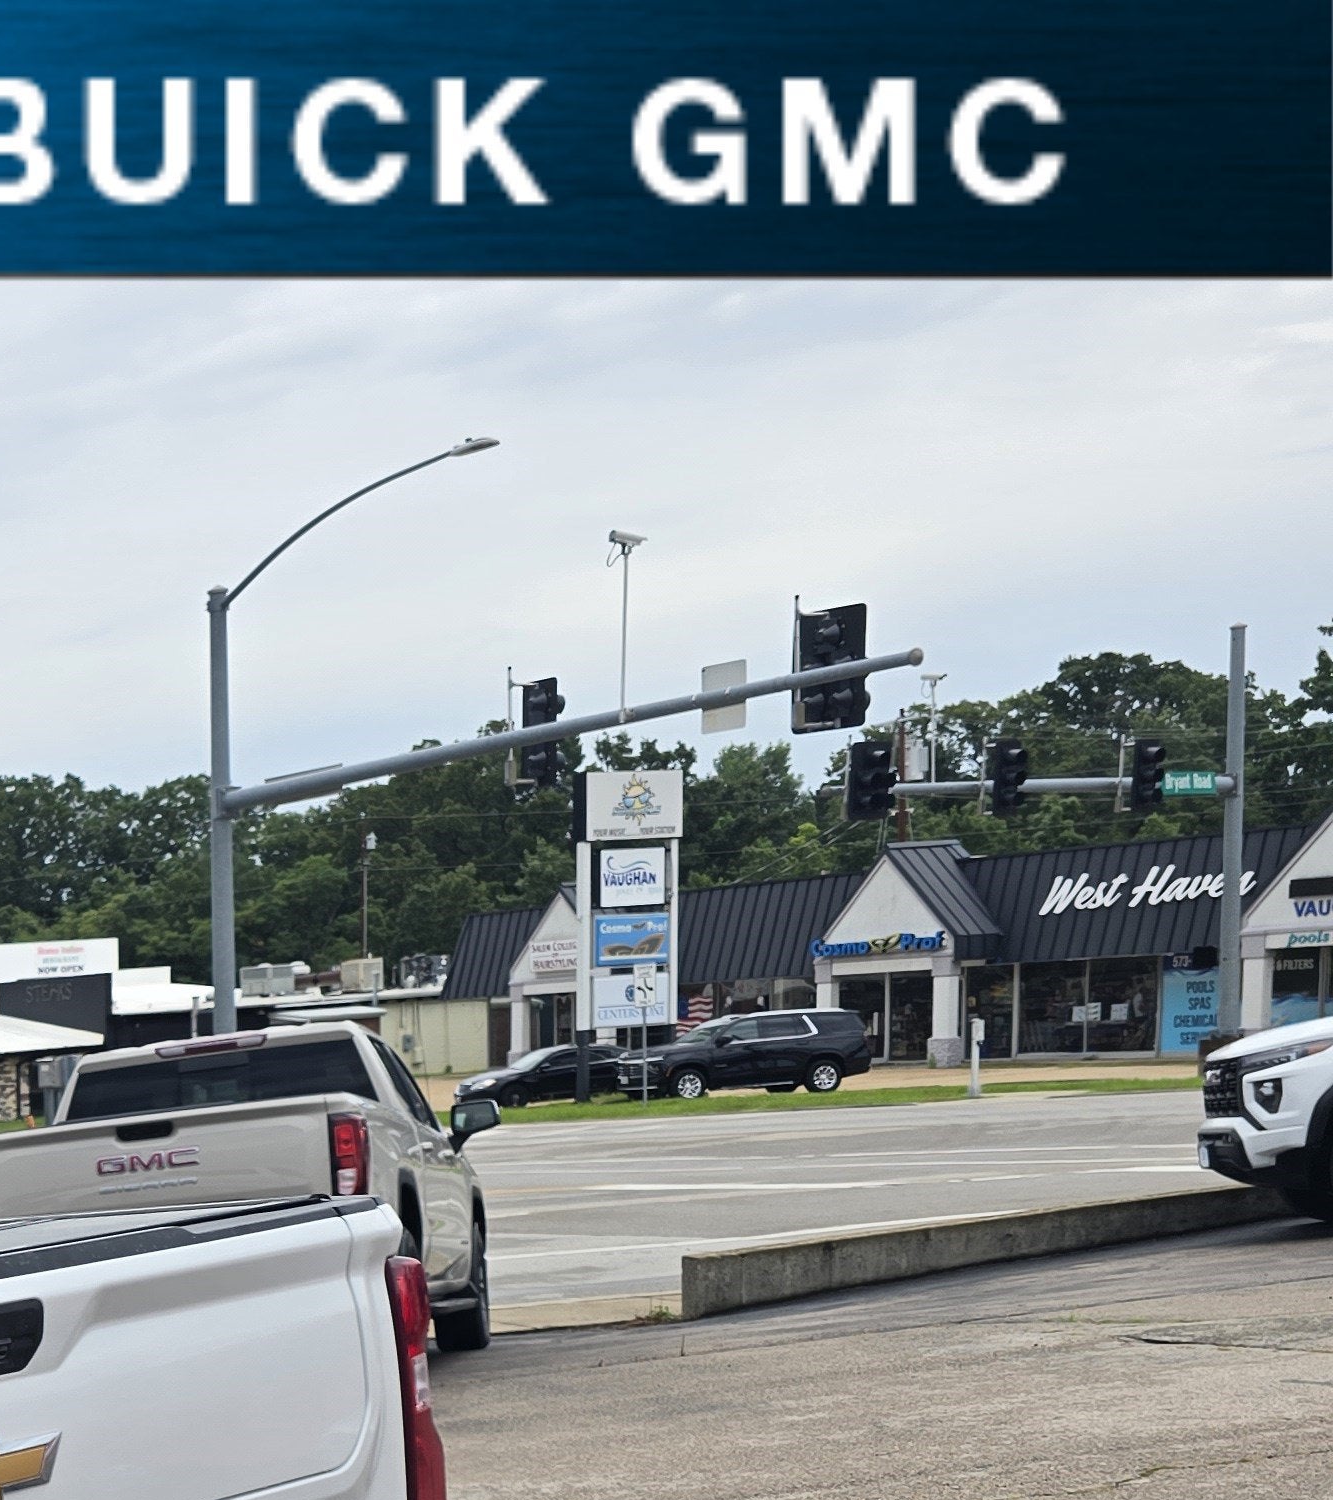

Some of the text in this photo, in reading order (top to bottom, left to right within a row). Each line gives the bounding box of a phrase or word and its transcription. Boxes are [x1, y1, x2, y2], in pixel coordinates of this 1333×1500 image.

[1165, 773, 1212, 793] Bryant Road
[603, 870, 657, 887] VAUGHAN
[1038, 872, 1130, 916] West
[1293, 899, 1333, 918] VAU
[810, 930, 947, 958] Cosmo Prof
[1286, 931, 1330, 949] pools
[37, 965, 84, 976] NOW OPEN
[1283, 958, 1314, 971] FILTERS
[26, 981, 72, 1003] STEAKS
[1186, 980, 1215, 994] POOLS
[1188, 997, 1212, 1011] SPAS
[97, 1146, 200, 1176] GMC
